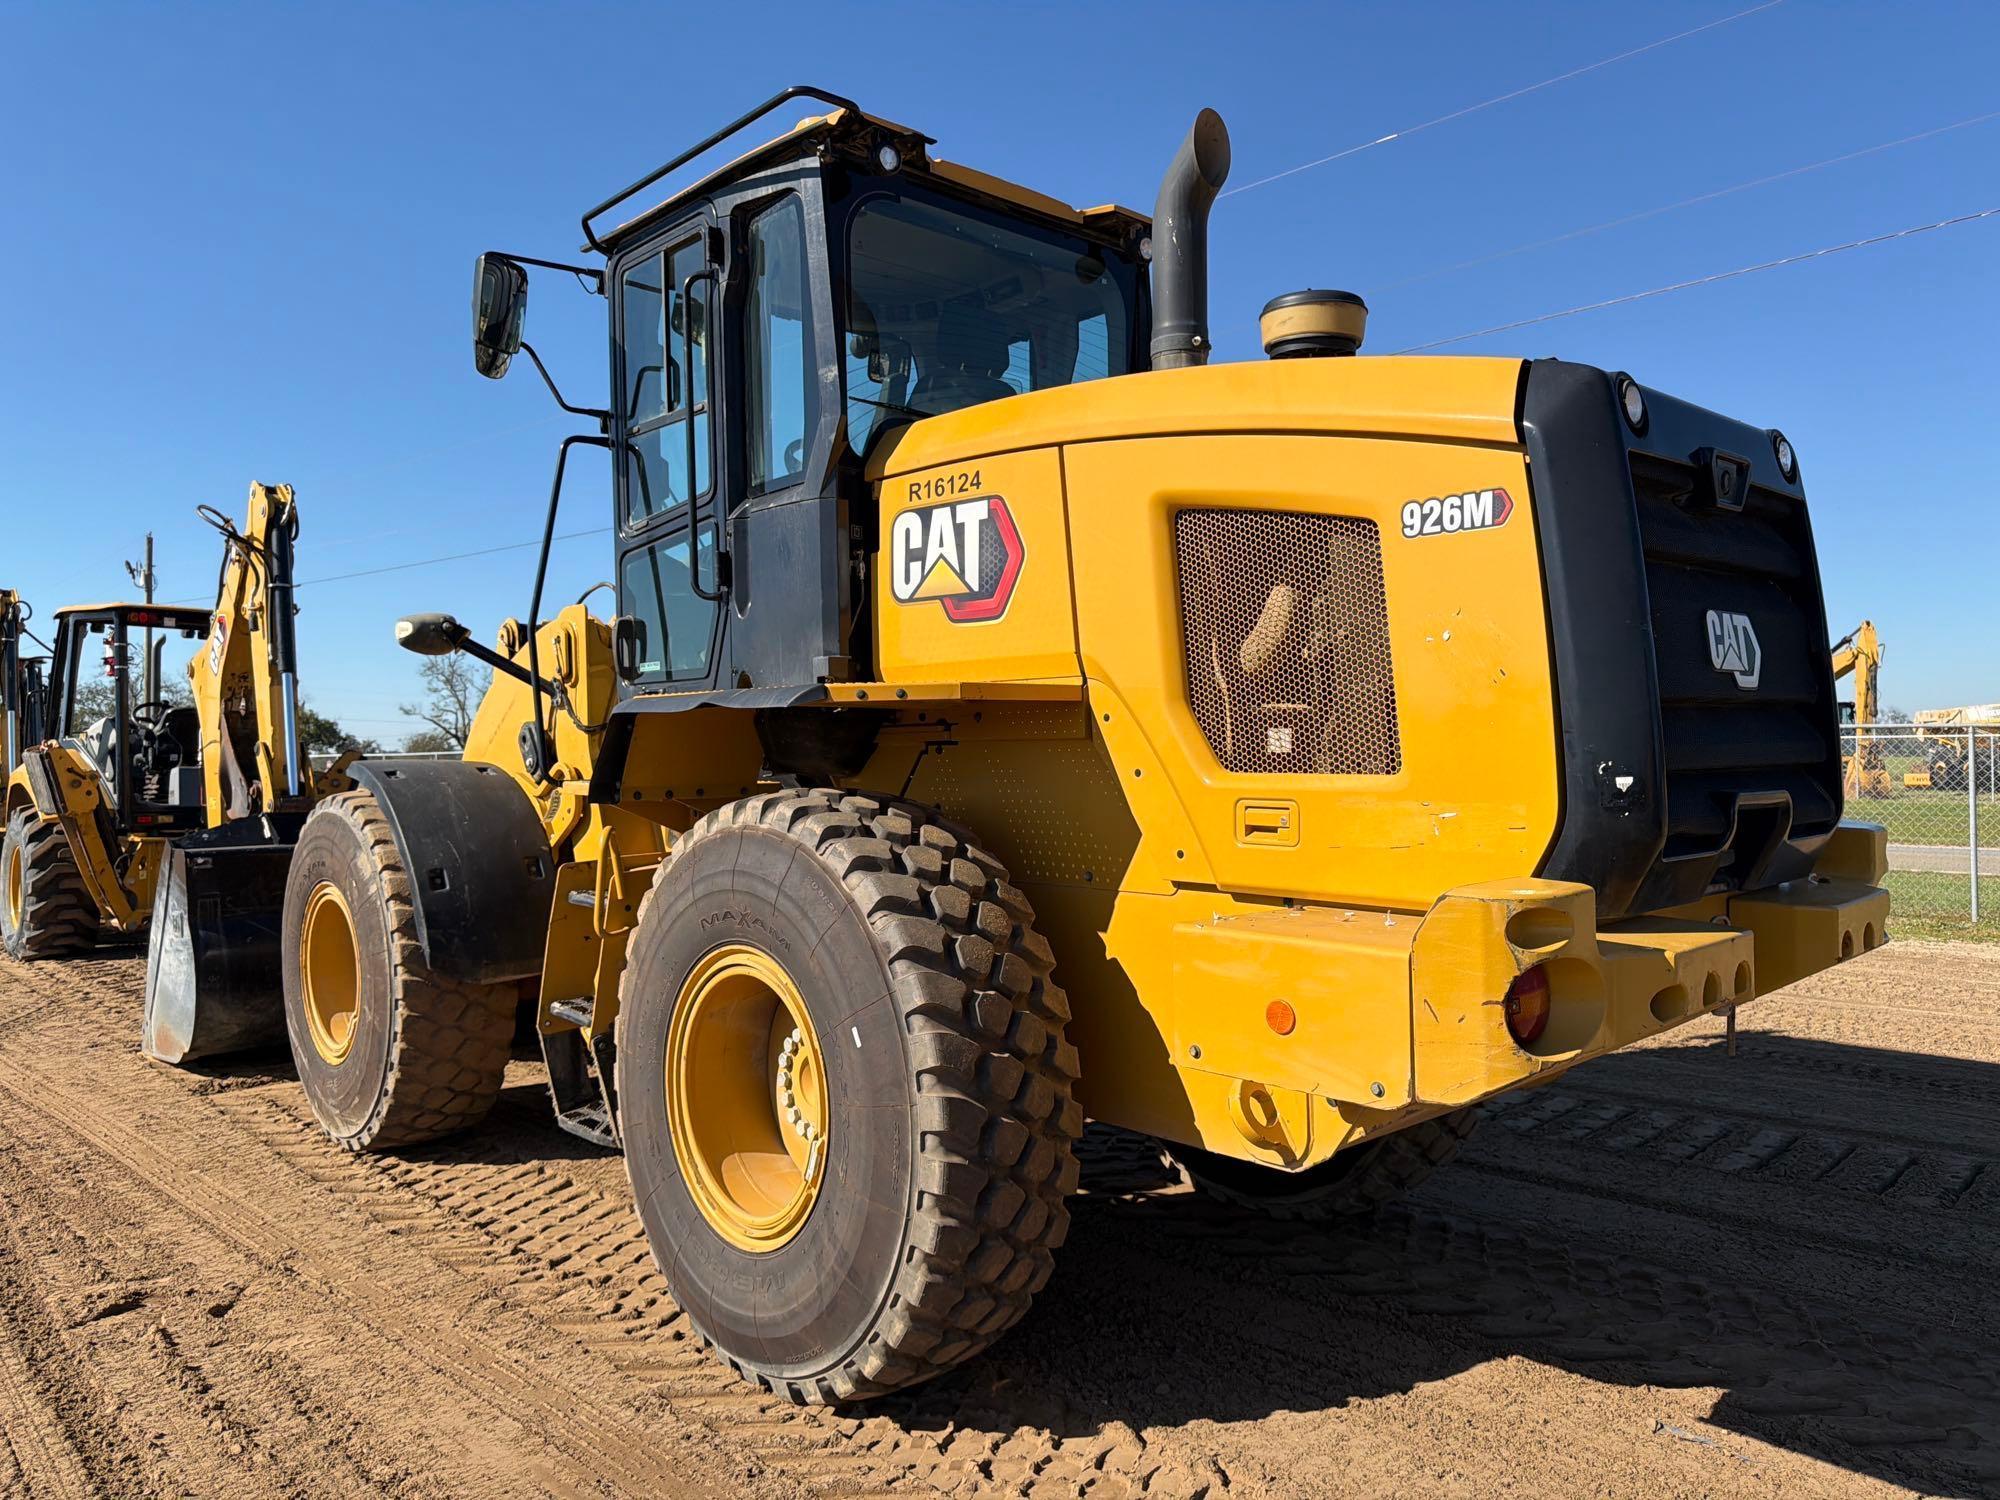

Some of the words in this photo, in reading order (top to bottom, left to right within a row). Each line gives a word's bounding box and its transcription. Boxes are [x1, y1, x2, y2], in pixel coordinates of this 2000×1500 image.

[909, 470, 982, 501] R16124
[1402, 490, 1493, 537] 926M
[892, 500, 989, 600] CAT
[1706, 610, 1749, 671] CAT
[700, 910, 791, 953] MAXAM
